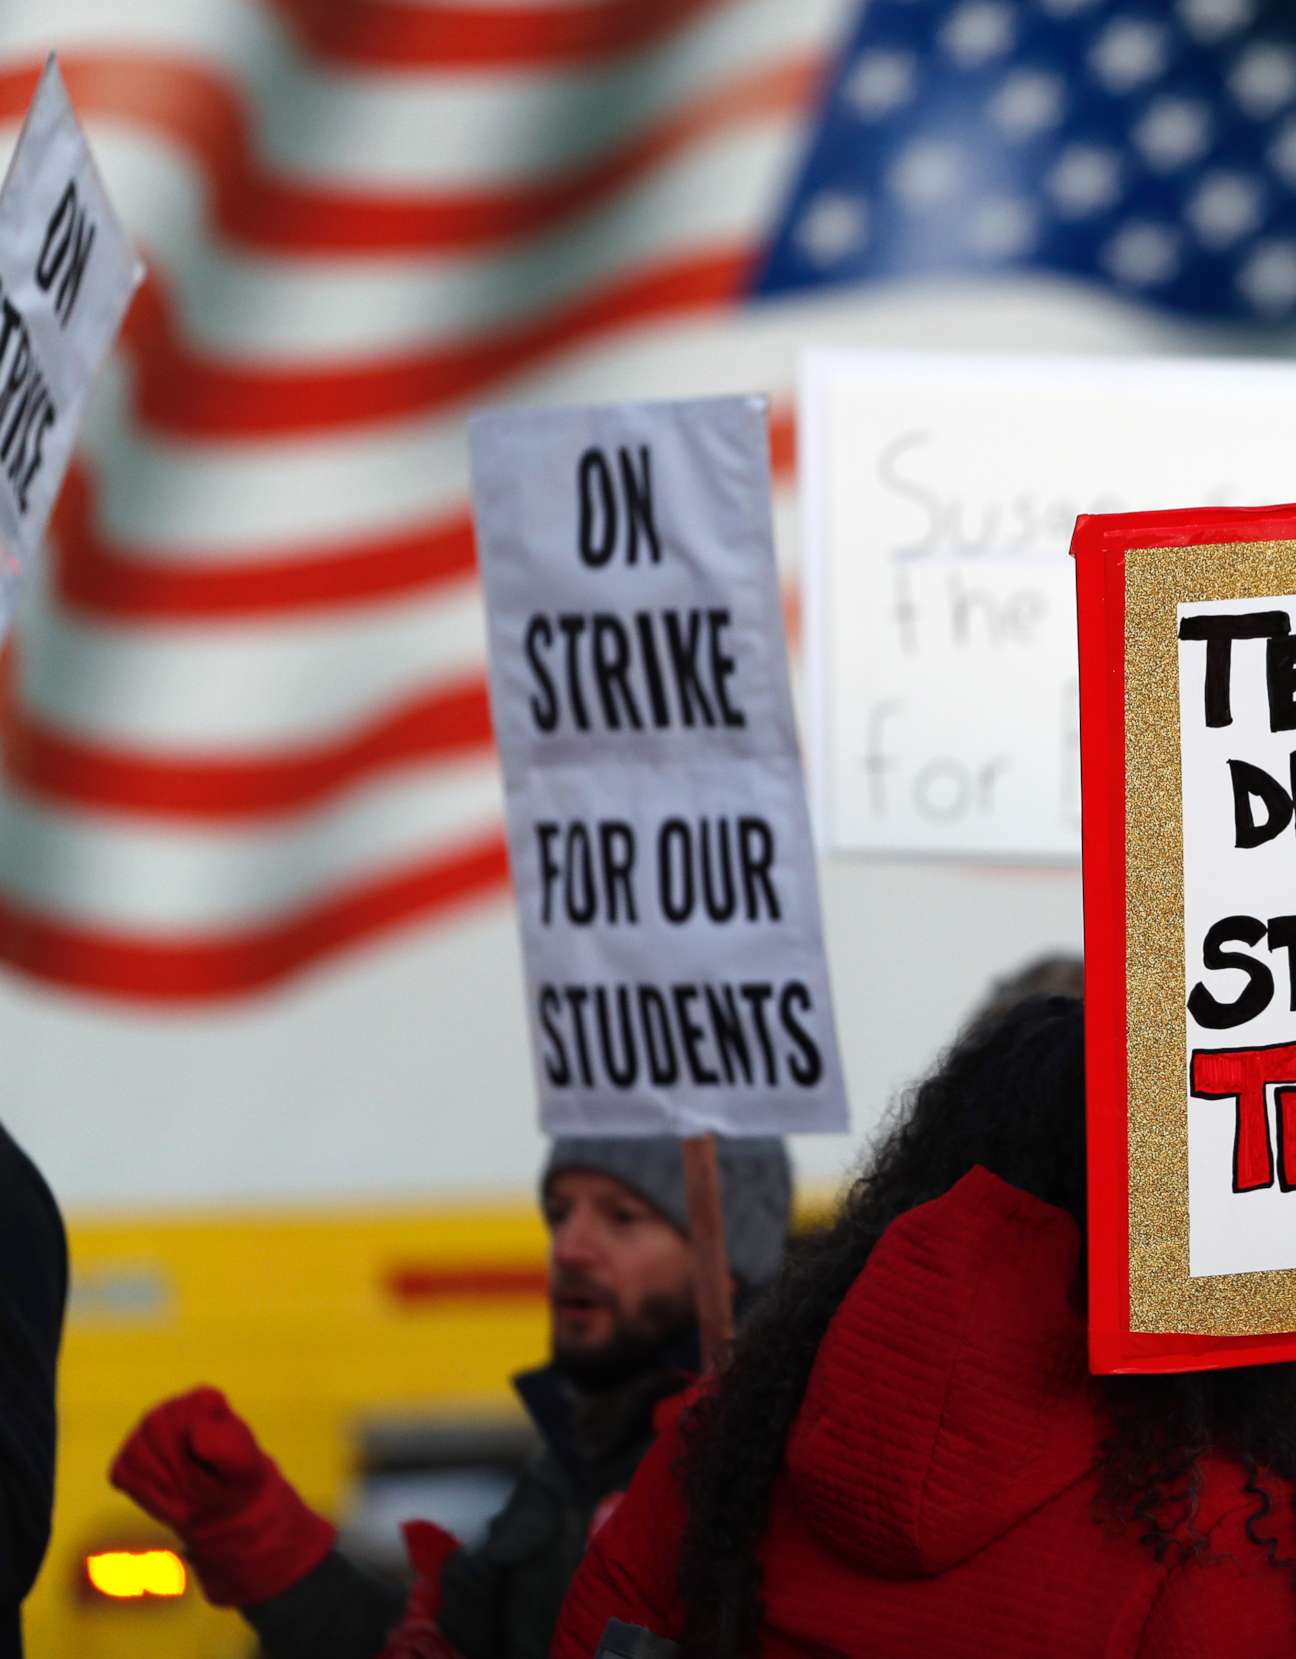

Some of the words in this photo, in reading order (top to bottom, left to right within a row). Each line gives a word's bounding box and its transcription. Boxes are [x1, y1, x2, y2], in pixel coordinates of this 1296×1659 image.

[35, 178, 96, 331] ON
[0, 272, 56, 515] TRIKE
[576, 445, 662, 570] ON
[525, 610, 747, 734] STRIKE
[535, 820, 637, 926] FOR
[657, 816, 782, 924] OUR
[539, 980, 823, 1090] STUDENTS
